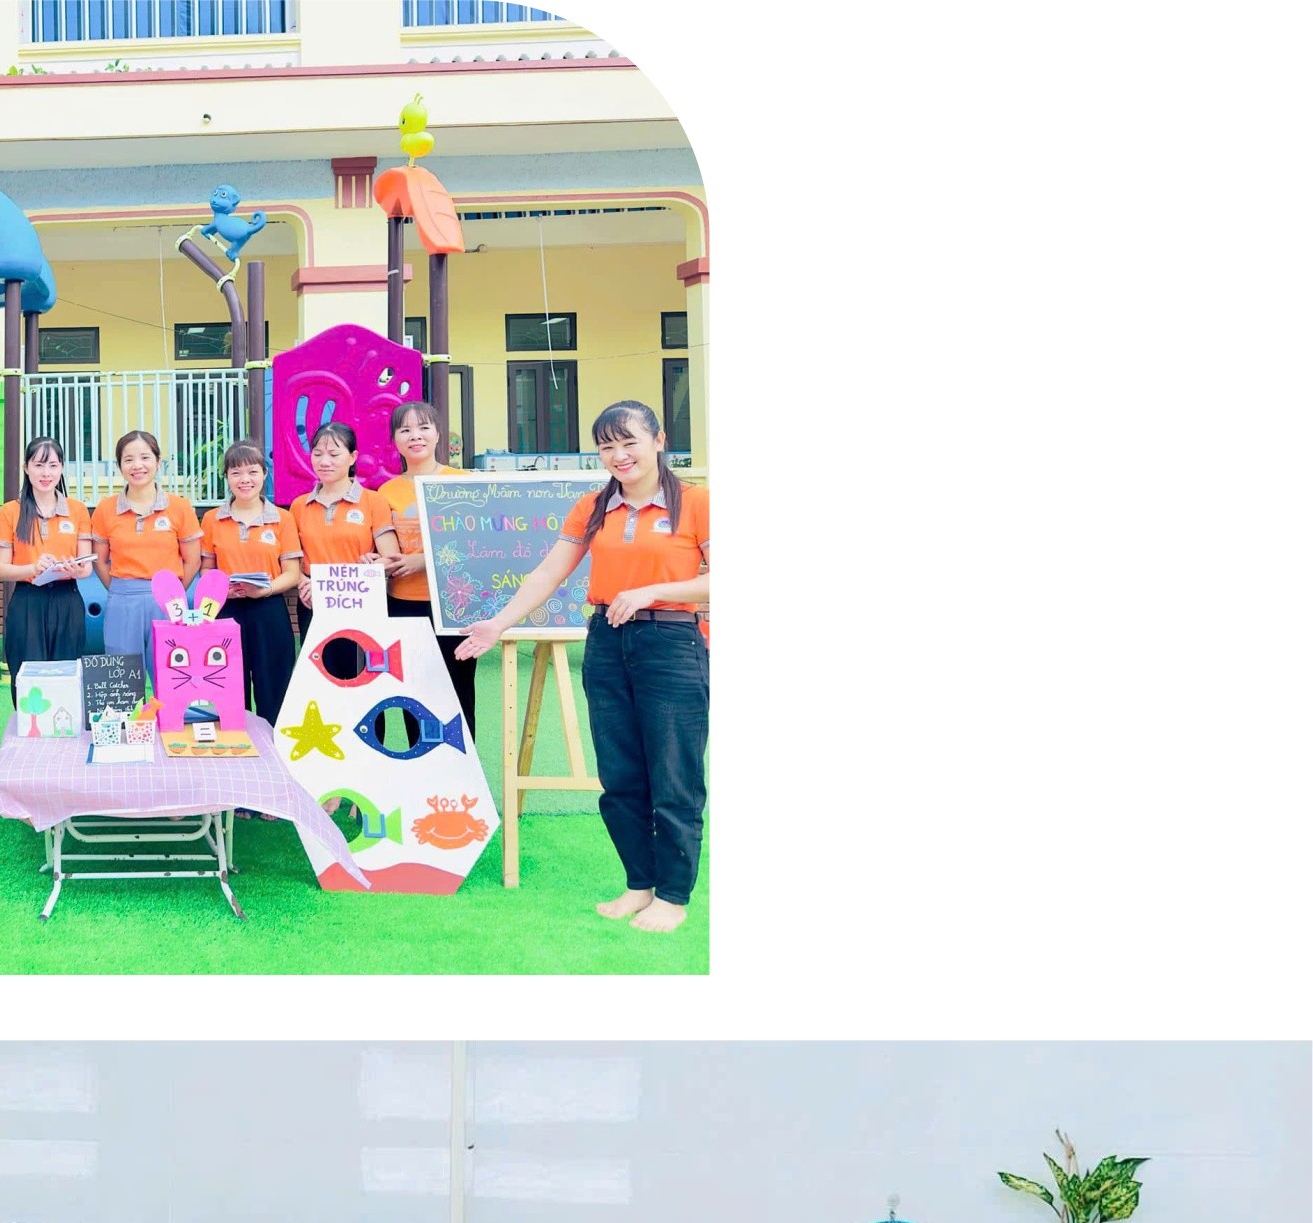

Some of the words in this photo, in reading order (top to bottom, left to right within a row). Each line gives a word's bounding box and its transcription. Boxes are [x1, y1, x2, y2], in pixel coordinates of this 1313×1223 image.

[527, 489, 554, 499] non
[431, 510, 476, 532] CHÀO
[480, 510, 528, 532] MỪNG
[330, 566, 359, 578] NÉM
[316, 579, 370, 593] TRÚNG
[325, 594, 363, 609] ĐÍCH
[175, 603, 183, 617] 3
[203, 602, 212, 617] 1
[129, 670, 141, 680] A1
